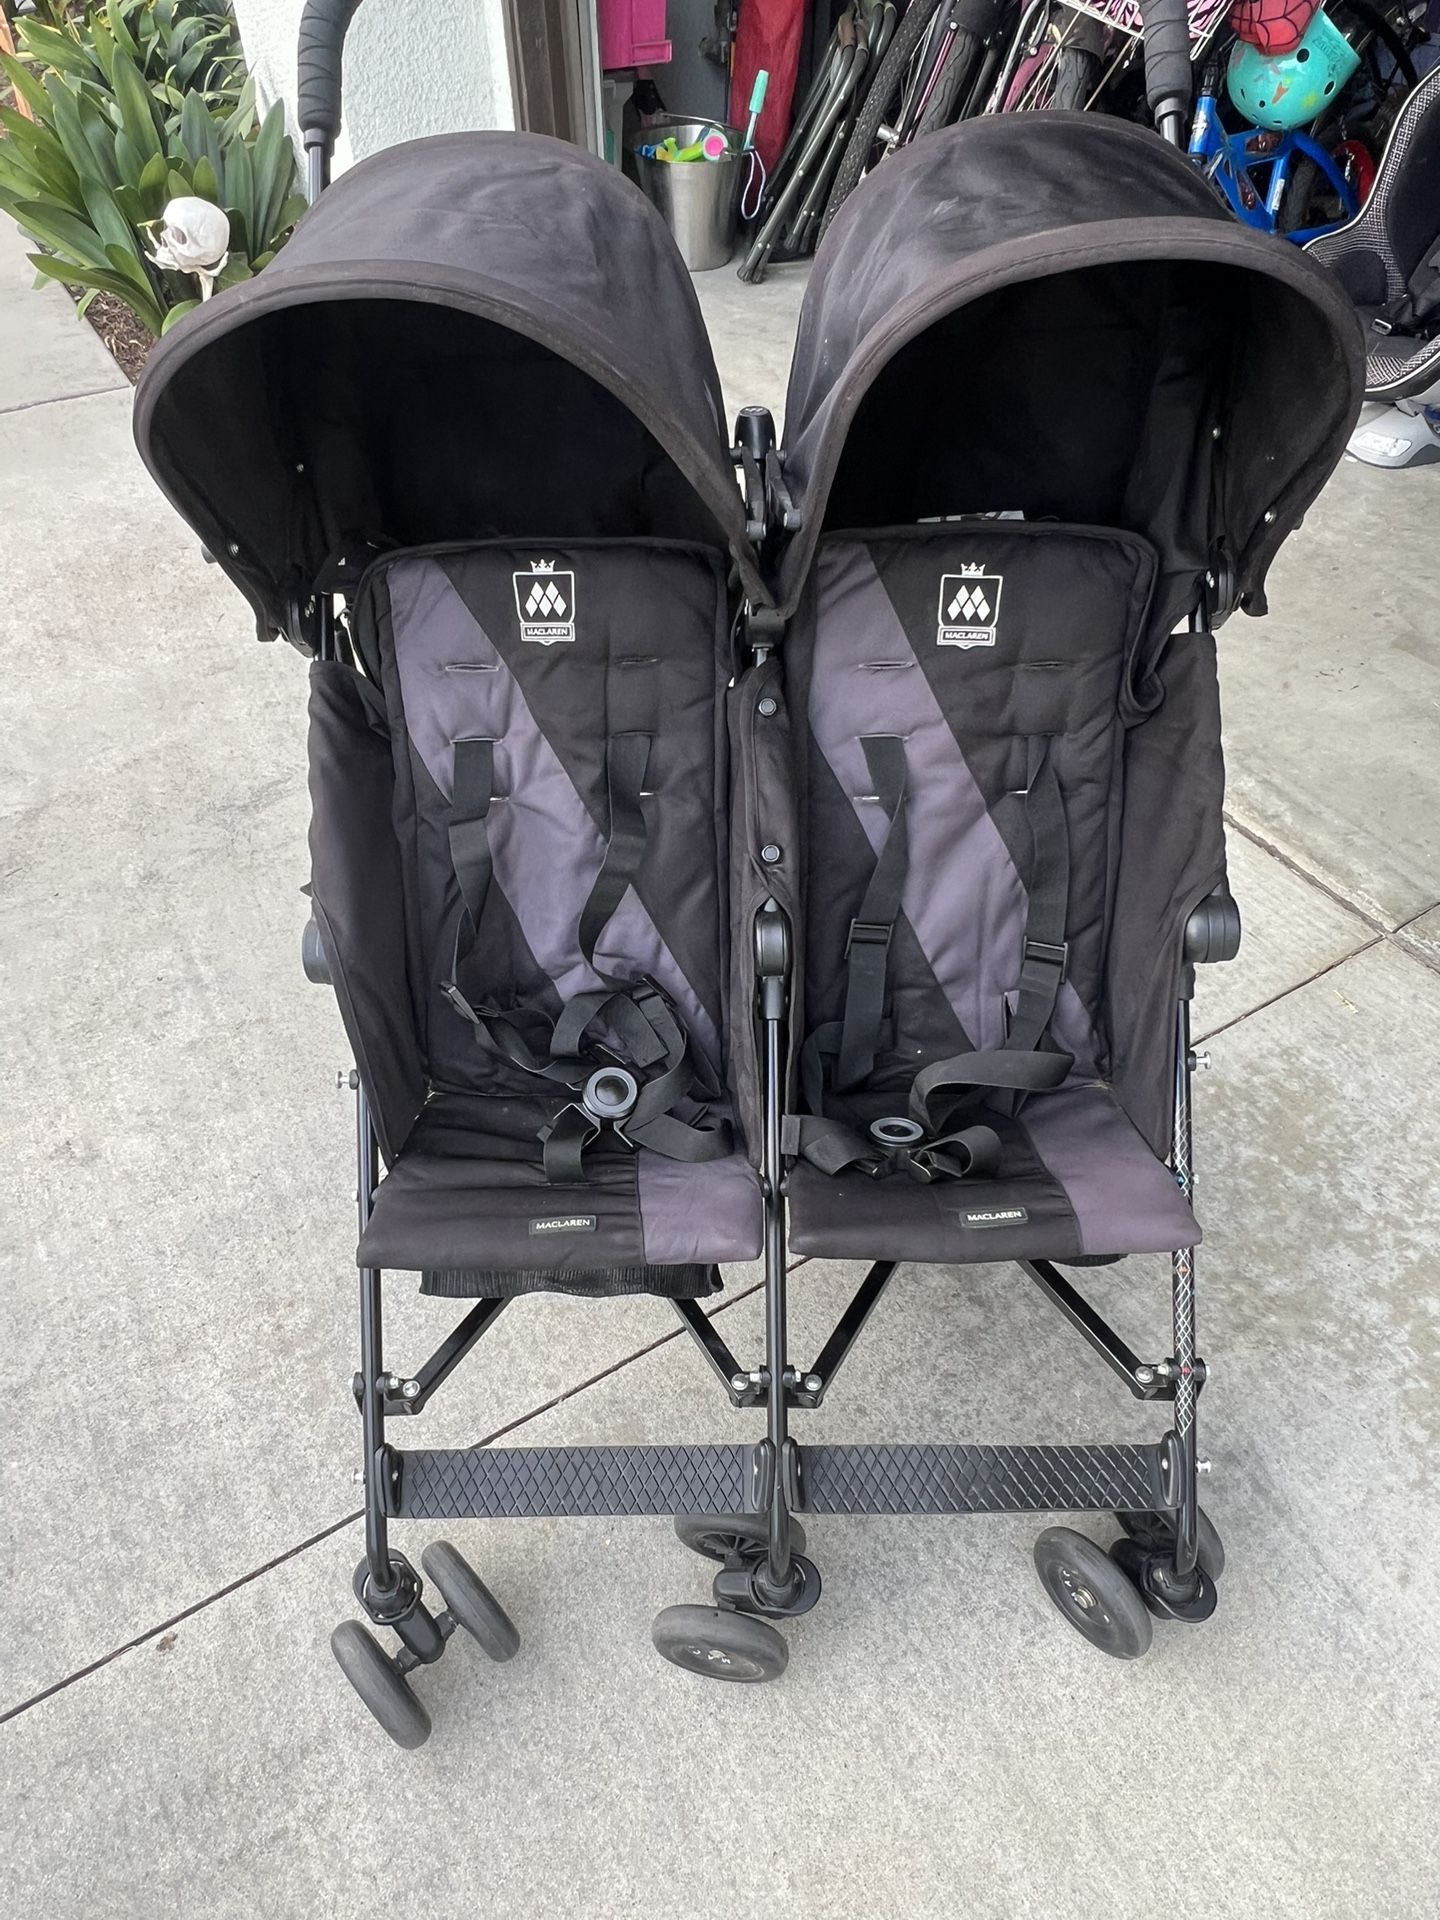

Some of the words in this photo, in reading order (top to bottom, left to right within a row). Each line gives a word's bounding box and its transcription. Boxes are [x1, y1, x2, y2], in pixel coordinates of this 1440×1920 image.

[526, 627, 569, 636] MACLAREN
[945, 631, 989, 640] MACLAREN
[966, 1211, 1022, 1221] MACLAREN
[535, 1219, 590, 1230] MACLAREN
